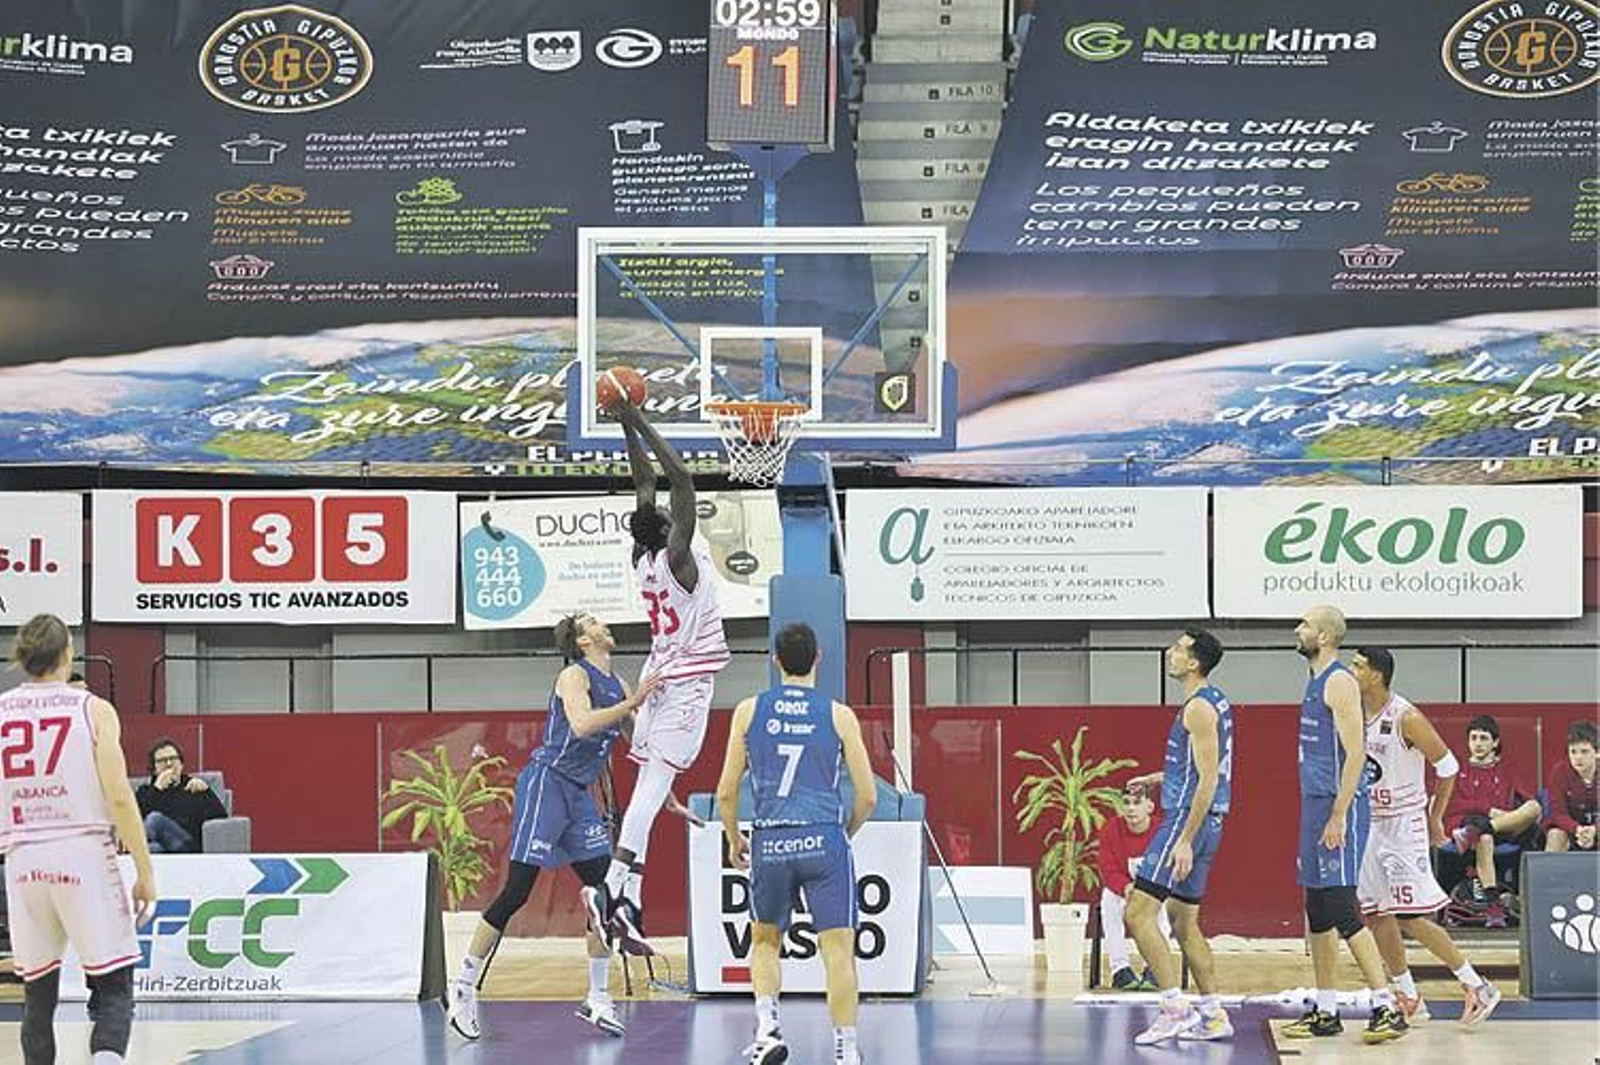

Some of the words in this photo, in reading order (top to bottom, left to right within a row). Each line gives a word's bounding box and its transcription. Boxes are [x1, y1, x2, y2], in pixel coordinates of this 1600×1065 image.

[716, 0, 820, 27] 02:59
[737, 27, 799, 39] MONDO
[1143, 26, 1377, 51] Naturklima
[0, 33, 133, 63] rklima
[727, 46, 799, 105] 11
[949, 86, 974, 96] FILA
[981, 84, 993, 95] 10
[945, 124, 971, 134] FILA
[1045, 111, 1229, 134] Aldaketa
[1242, 119, 1375, 136] txikiek
[44, 128, 177, 146] txikiek
[1045, 136, 1174, 154] eragin
[1185, 138, 1361, 153] handiak
[945, 162, 970, 173] FILA
[1045, 152, 1130, 171] izan
[1142, 154, 1331, 171] ditzakete
[1036, 182, 1101, 198] Los
[1108, 183, 1305, 200] pequeños
[35, 207, 189, 223] pueden
[1029, 200, 1198, 213] cambios
[1206, 198, 1362, 214] pueden
[1023, 217, 1127, 231] tener
[1133, 216, 1303, 233] grandes
[878, 506, 935, 565] a
[1264, 502, 1526, 565] ékolo
[474, 546, 519, 567] 943
[476, 567, 522, 586] 444
[1263, 573, 1372, 594] produktu
[1380, 571, 1524, 596] ekologikoak
[136, 592, 242, 609] SERVICIOS
[249, 591, 282, 608] TIC
[287, 590, 409, 608] AVANZADOS
[477, 586, 522, 607] 660
[0, 717, 72, 779] 27
[777, 744, 804, 797] 7
[136, 897, 299, 969] FCC
